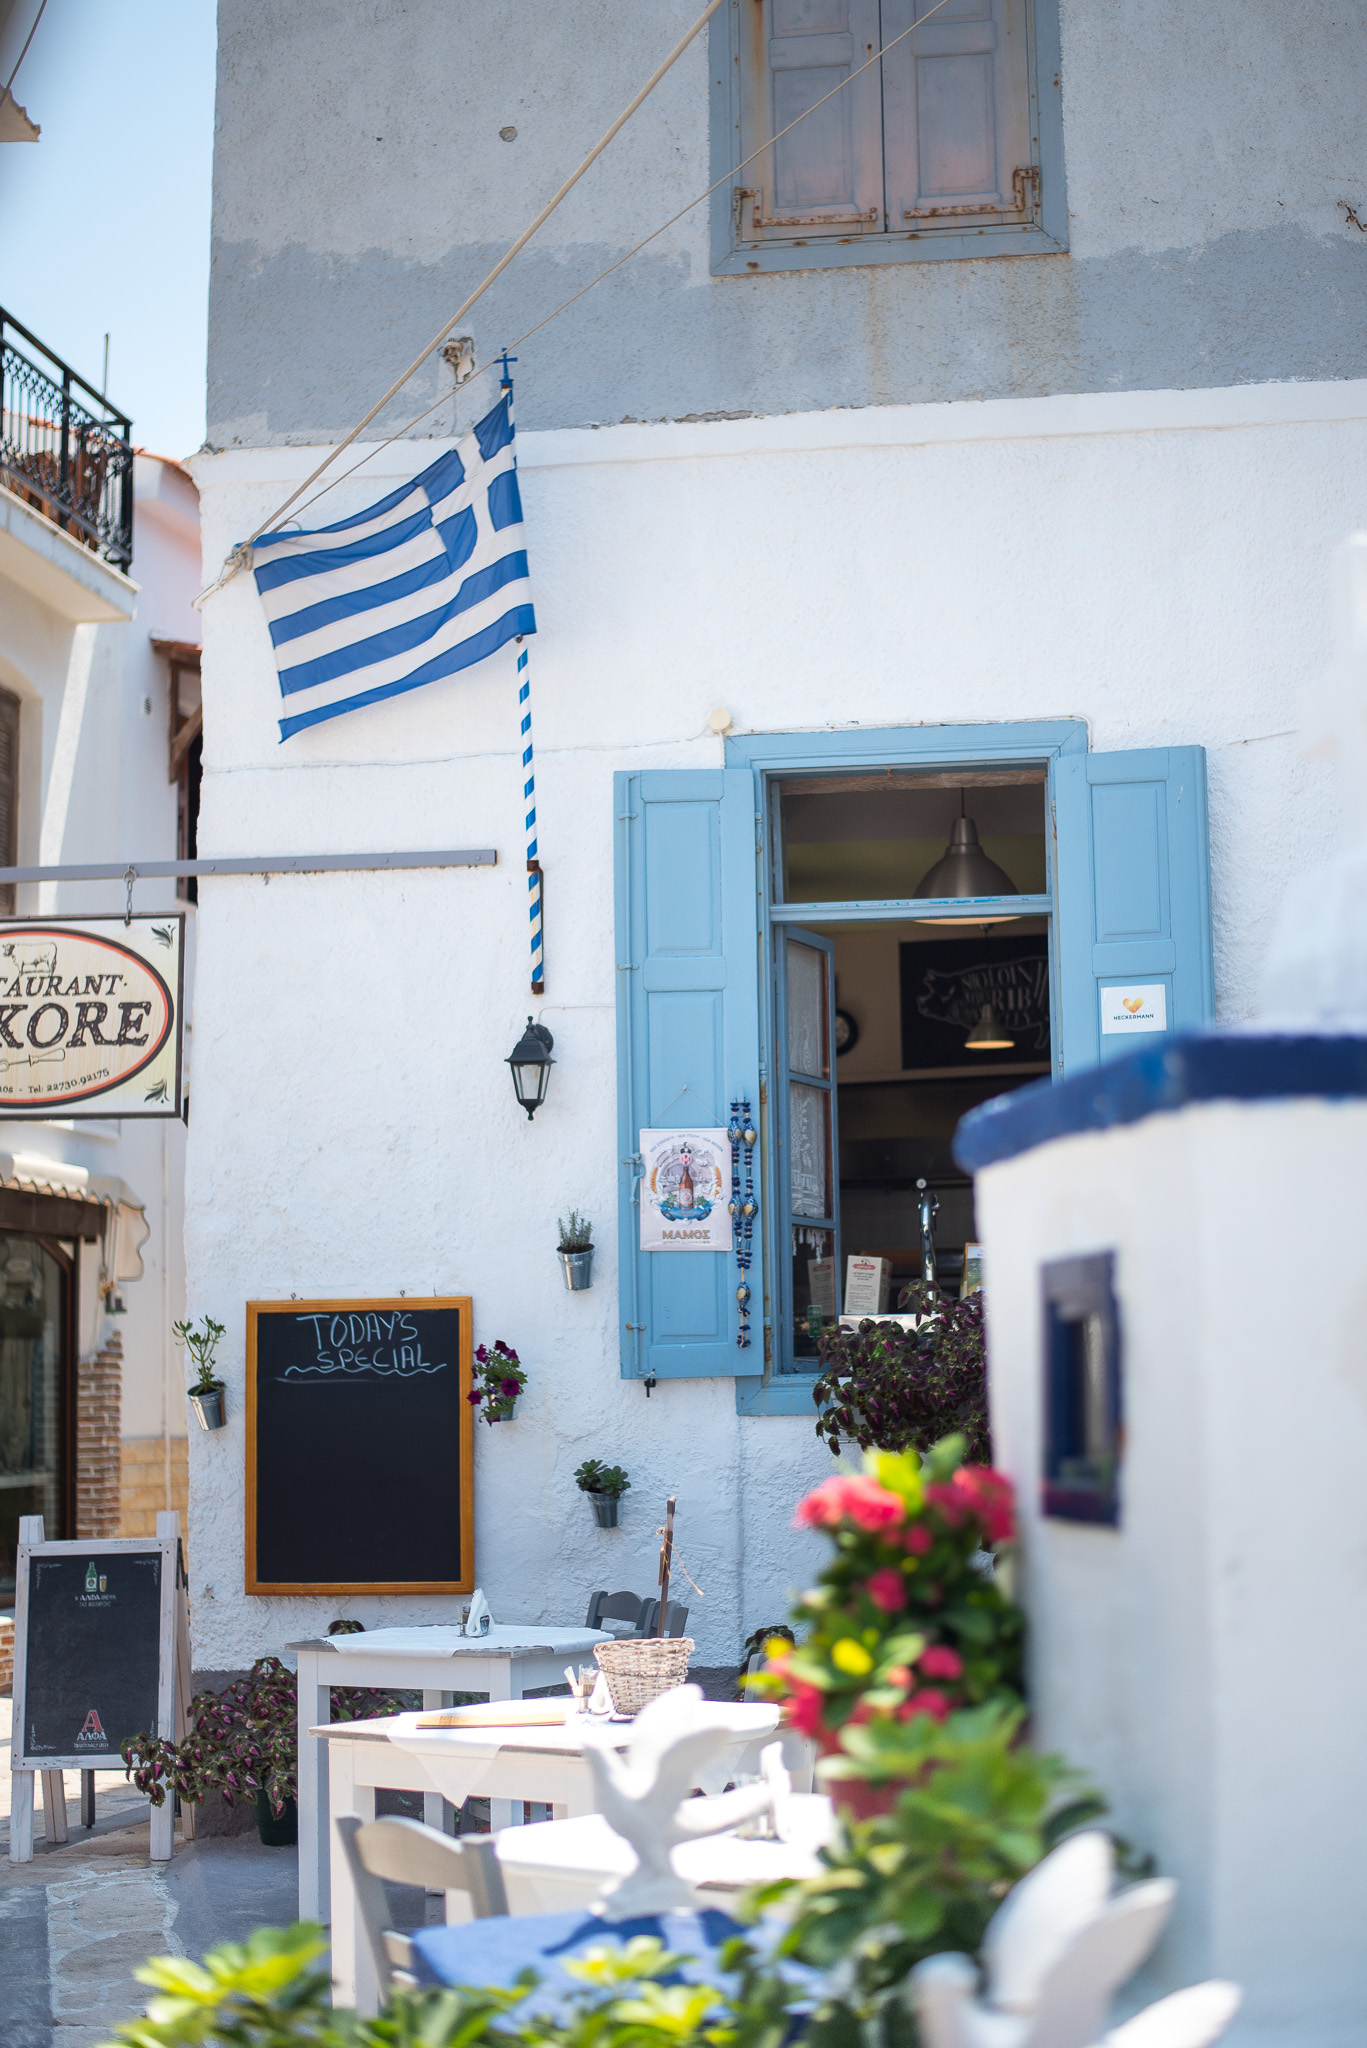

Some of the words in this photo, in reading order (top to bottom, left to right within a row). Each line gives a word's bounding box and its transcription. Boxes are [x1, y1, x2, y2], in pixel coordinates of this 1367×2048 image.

[28, 1084, 44, 1093] Tel:
[47, 1068, 110, 1092] 22730.92175
[662, 1229, 711, 1240] ΜΑΜΟΣ
[317, 1344, 431, 1369] SPECIAL
[77, 1732, 107, 1741] ΑΛΦΑ
